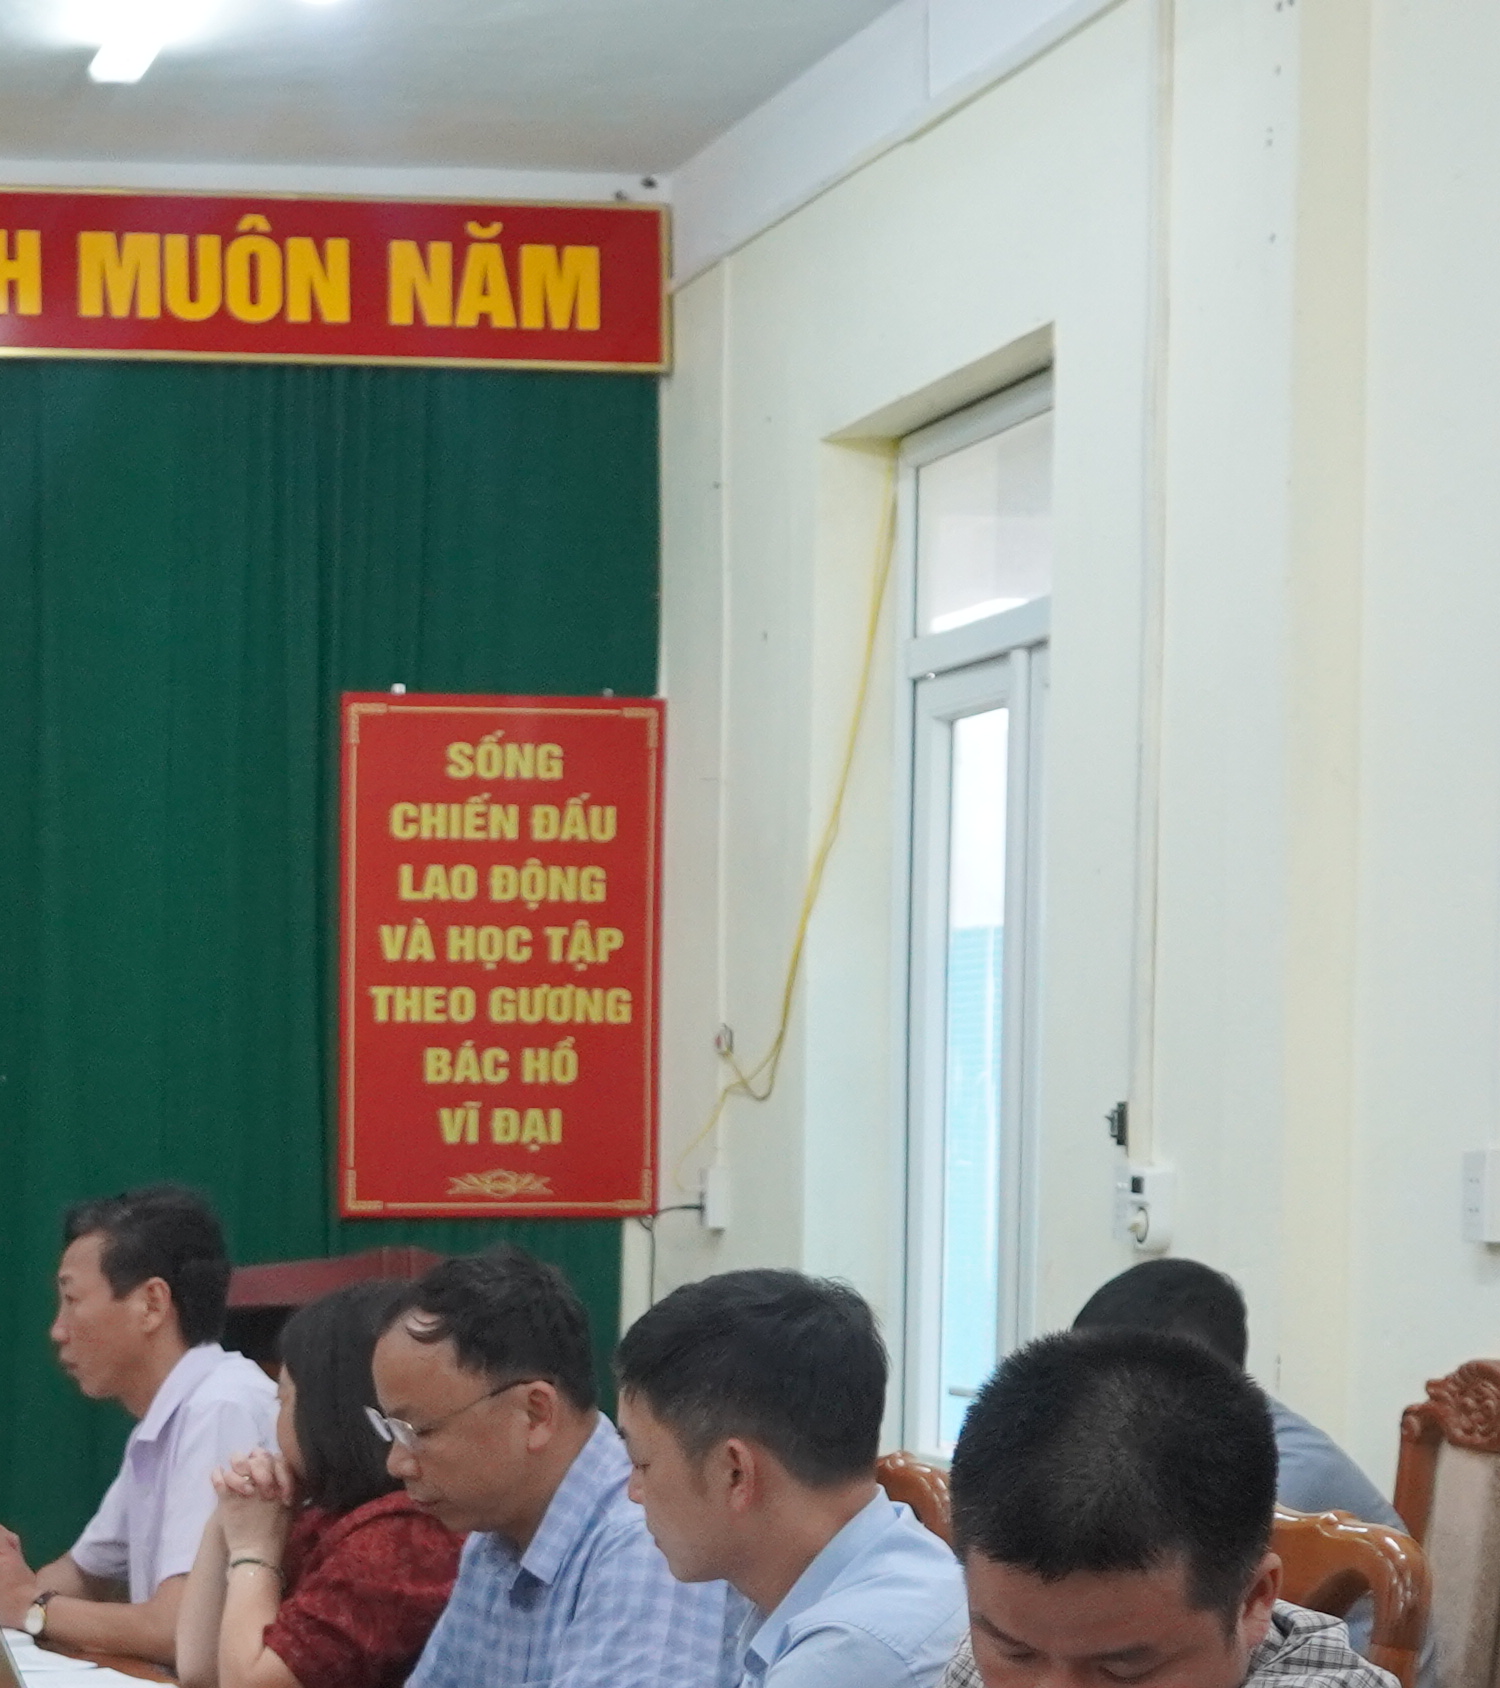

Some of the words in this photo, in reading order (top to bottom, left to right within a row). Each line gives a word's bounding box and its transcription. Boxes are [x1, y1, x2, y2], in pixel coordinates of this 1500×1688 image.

[78, 213, 351, 324] MUÔN
[388, 221, 601, 331] NĂM
[446, 730, 563, 780] SỐNG
[389, 793, 520, 840] CHIẾN
[531, 793, 617, 843] ĐẤU
[399, 864, 477, 902] LAO
[489, 858, 606, 910] ĐỘNG
[379, 918, 435, 963] VÀ
[447, 925, 532, 970] HỌC
[544, 919, 624, 971] TẬP
[369, 985, 476, 1023] THEO
[488, 983, 632, 1025] GƯƠNG
[423, 1040, 510, 1084] BÁC
[439, 1101, 479, 1144] VĨ
[491, 1108, 562, 1151] ĐẠI
